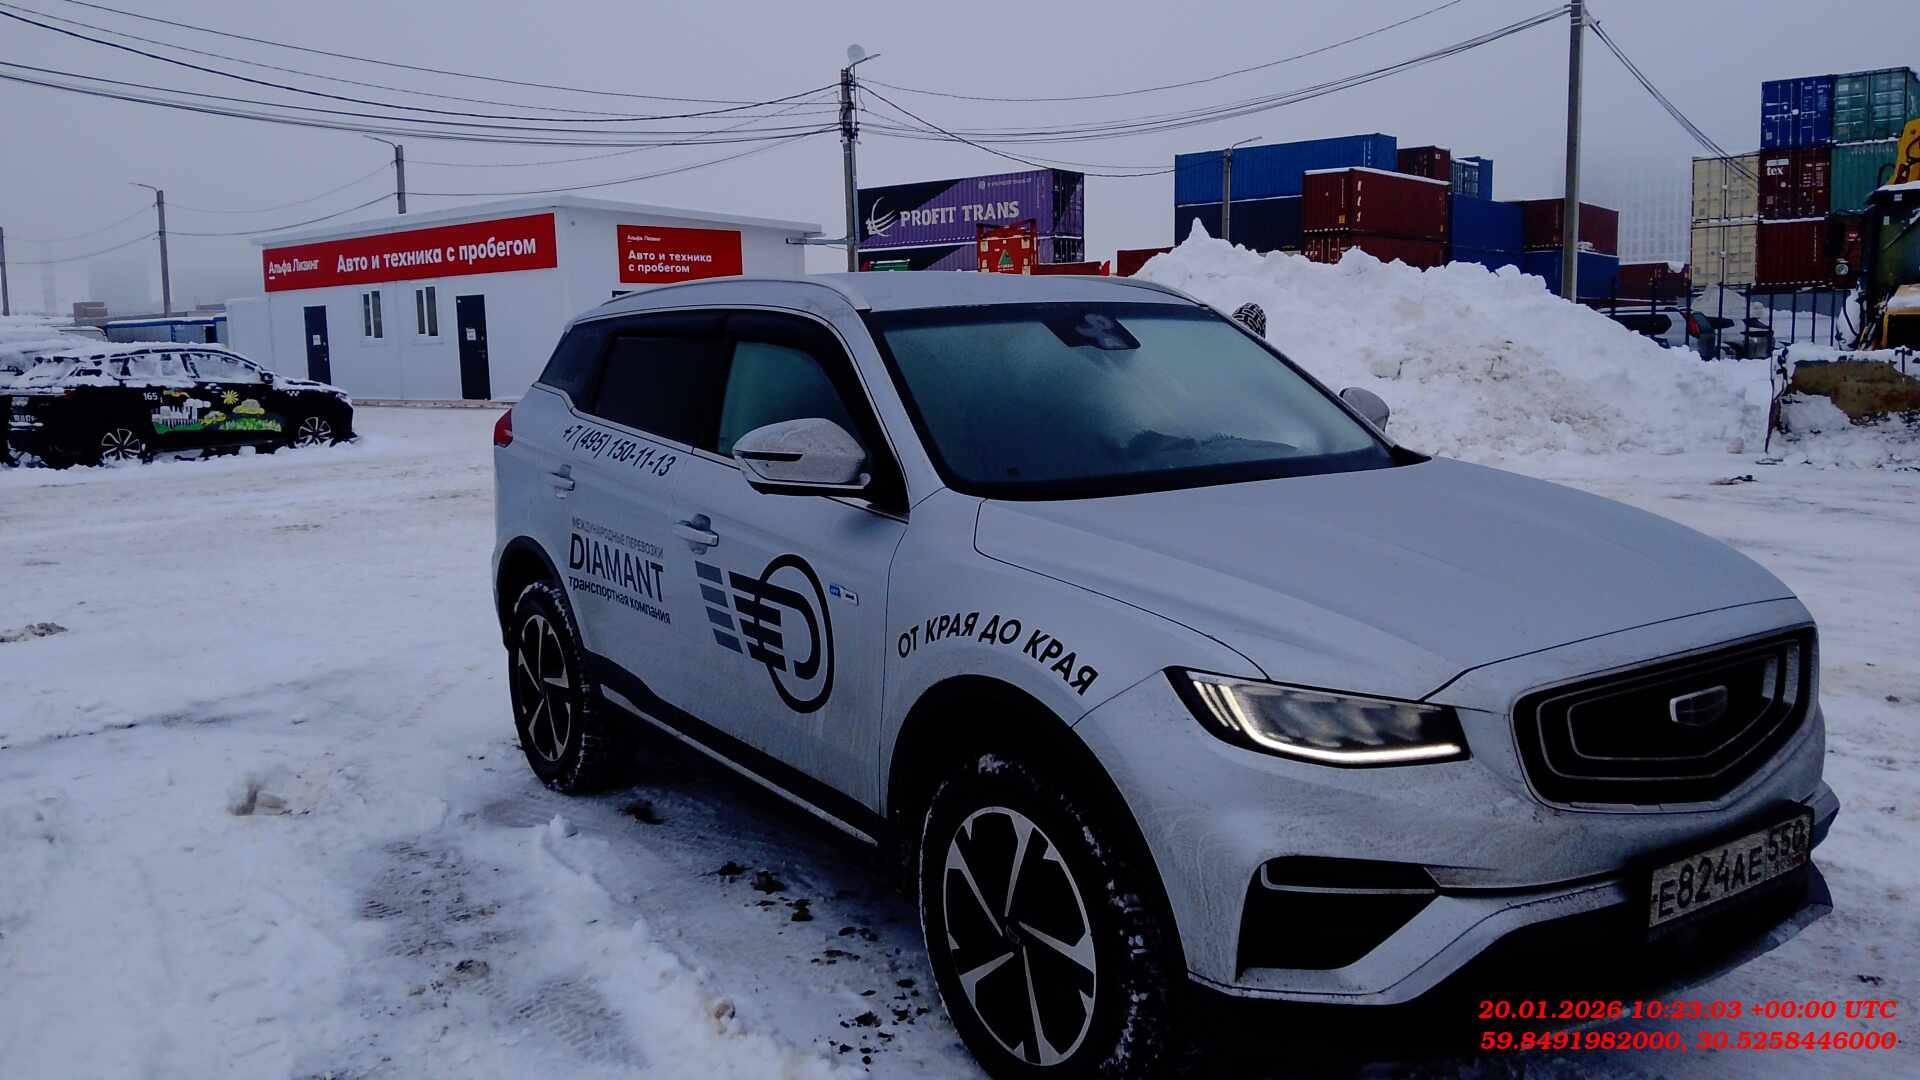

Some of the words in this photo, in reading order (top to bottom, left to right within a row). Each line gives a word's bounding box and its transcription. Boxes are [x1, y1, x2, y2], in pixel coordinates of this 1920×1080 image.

[900, 206, 957, 227] PROFIT
[961, 201, 1020, 222] TRANS
[268, 260, 292, 276] Альфа
[337, 254, 368, 273] Авто
[371, 254, 380, 269] и
[383, 248, 442, 268] техника
[446, 246, 456, 262] с
[459, 236, 537, 265] пробегом
[628, 249, 656, 261] Авто
[658, 252, 665, 261] и
[669, 252, 712, 263] техника
[628, 263, 635, 272] с
[637, 262, 690, 275] пробегом
[607, 438, 677, 476] 150-11-13
[569, 532, 664, 602] DIAMANT
[568, 575, 629, 607] транспортная
[630, 596, 671, 624] компания
[898, 625, 919, 658] ОТ
[925, 612, 980, 644] КРАЯ
[978, 614, 1022, 645] ДО
[1023, 629, 1099, 696] КРАЯ
